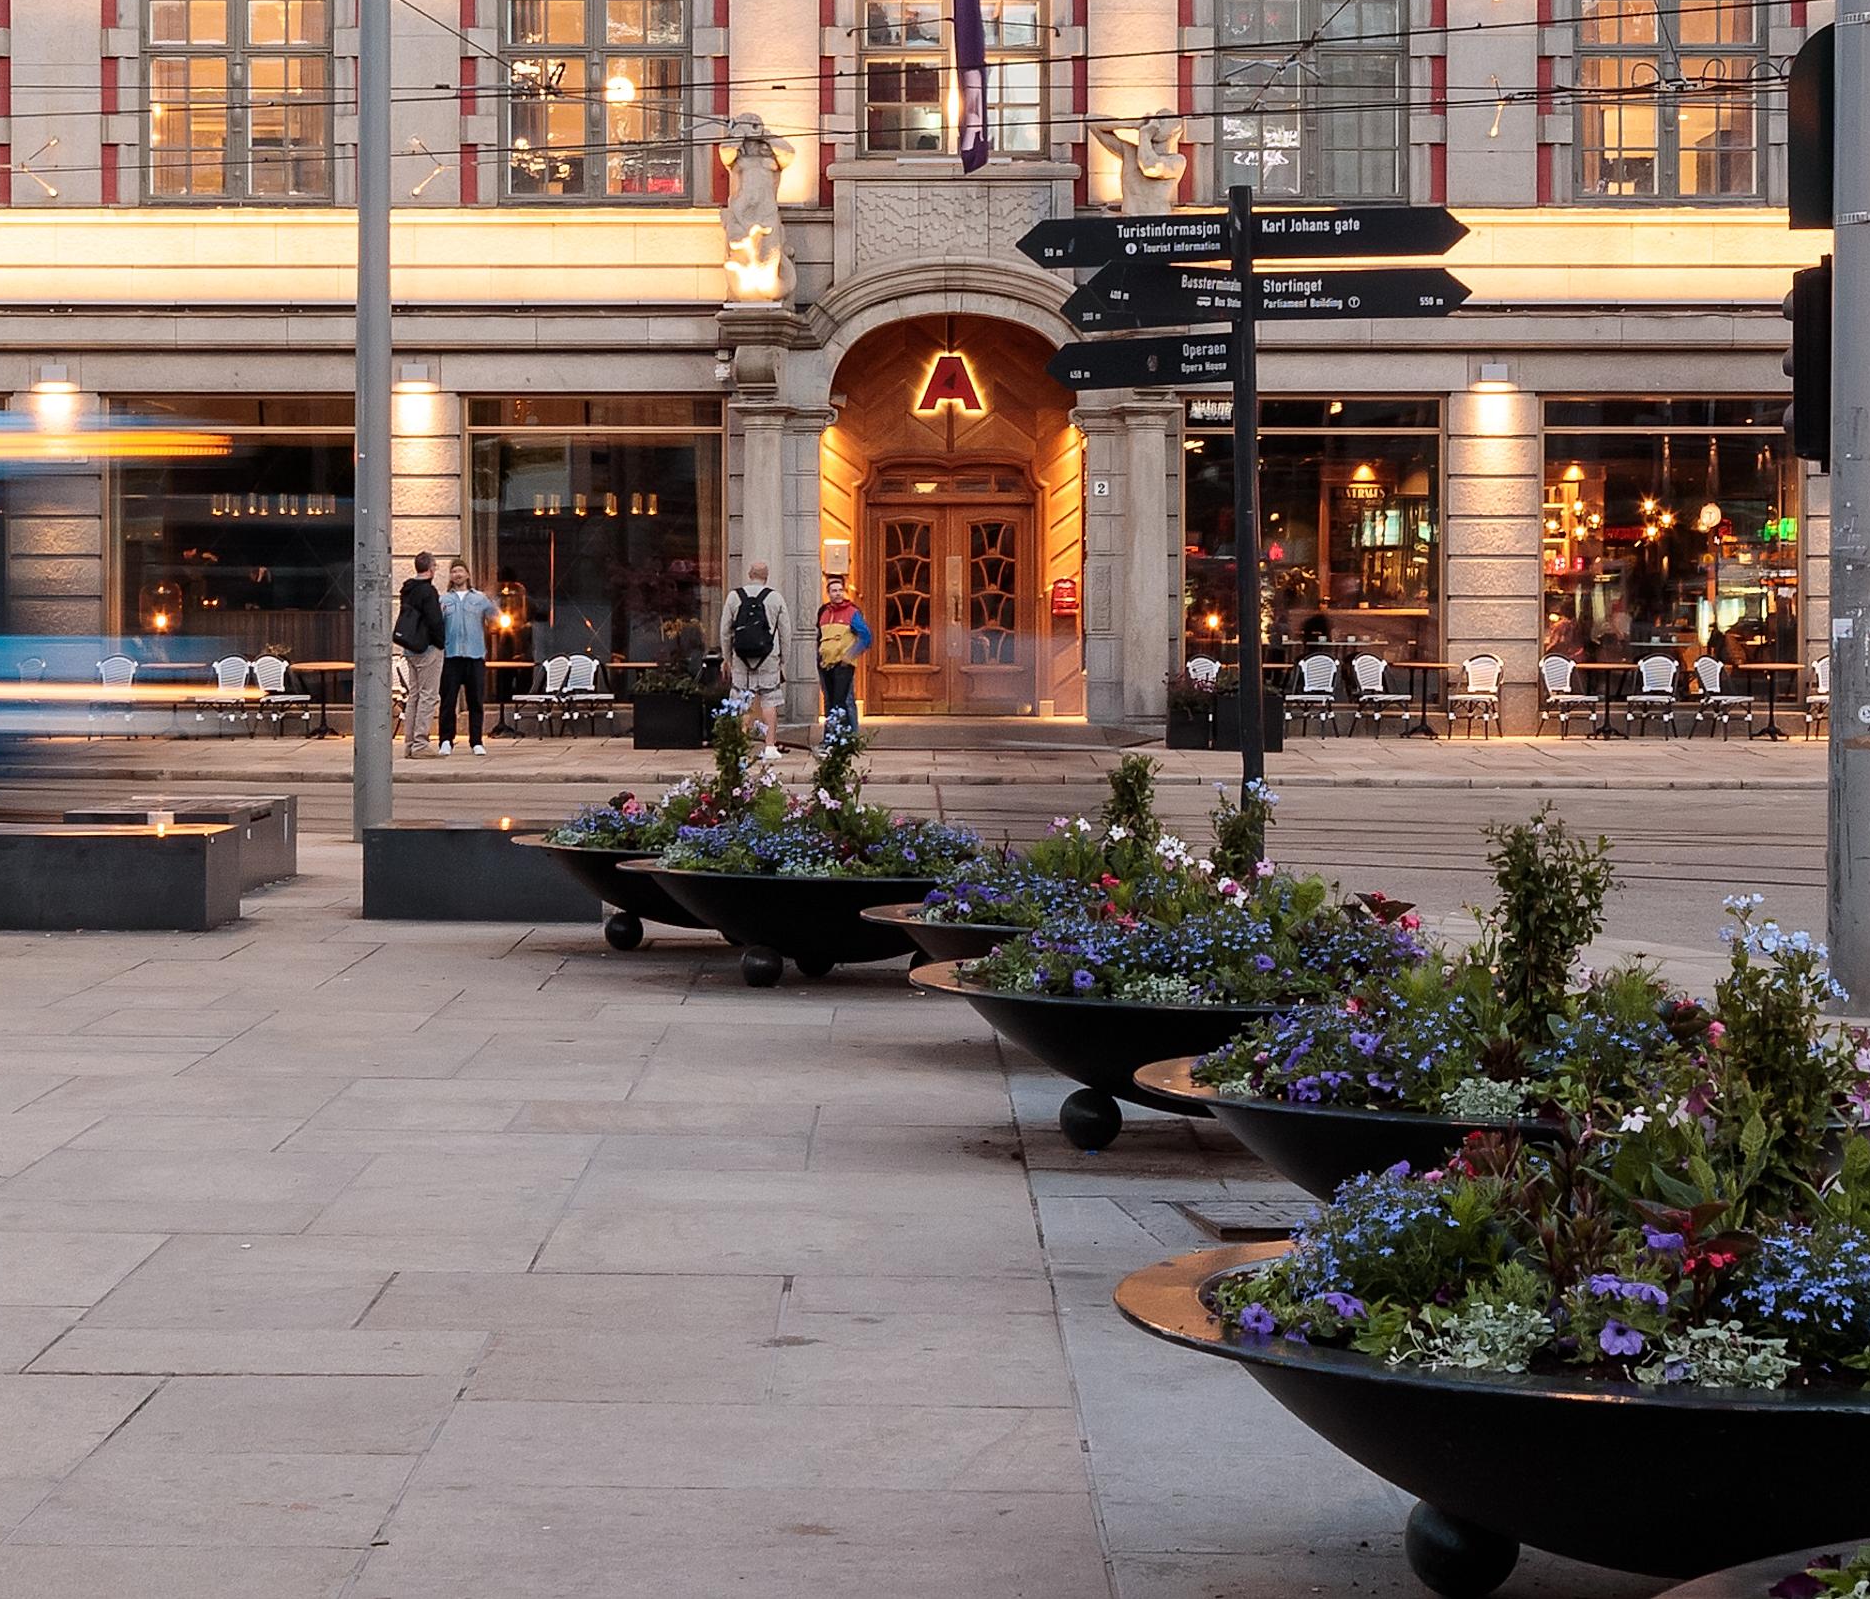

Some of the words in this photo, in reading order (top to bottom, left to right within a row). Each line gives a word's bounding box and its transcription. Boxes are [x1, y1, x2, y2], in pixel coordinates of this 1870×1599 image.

[1116, 221, 1221, 239] Turistinformasjon
[1261, 218, 1286, 233] Karl
[1289, 218, 1330, 232] Johans
[1334, 218, 1360, 235] gate
[1044, 248, 1054, 257] 50
[1055, 249, 1064, 257] m
[1143, 243, 1171, 253] Tourist
[1173, 241, 1221, 252] information
[1262, 278, 1323, 296] Stortinget
[1122, 292, 1130, 300] m
[1419, 296, 1434, 306] 550
[1435, 298, 1444, 306] m
[1263, 297, 1307, 309] Parliament
[1309, 297, 1343, 310] Building
[1182, 343, 1227, 359] Operaen
[1181, 362, 1203, 373] Opera
[1204, 361, 1227, 371] House
[1083, 371, 1091, 379] m
[916, 355, 984, 411] A
[1097, 483, 1106, 495] 2
